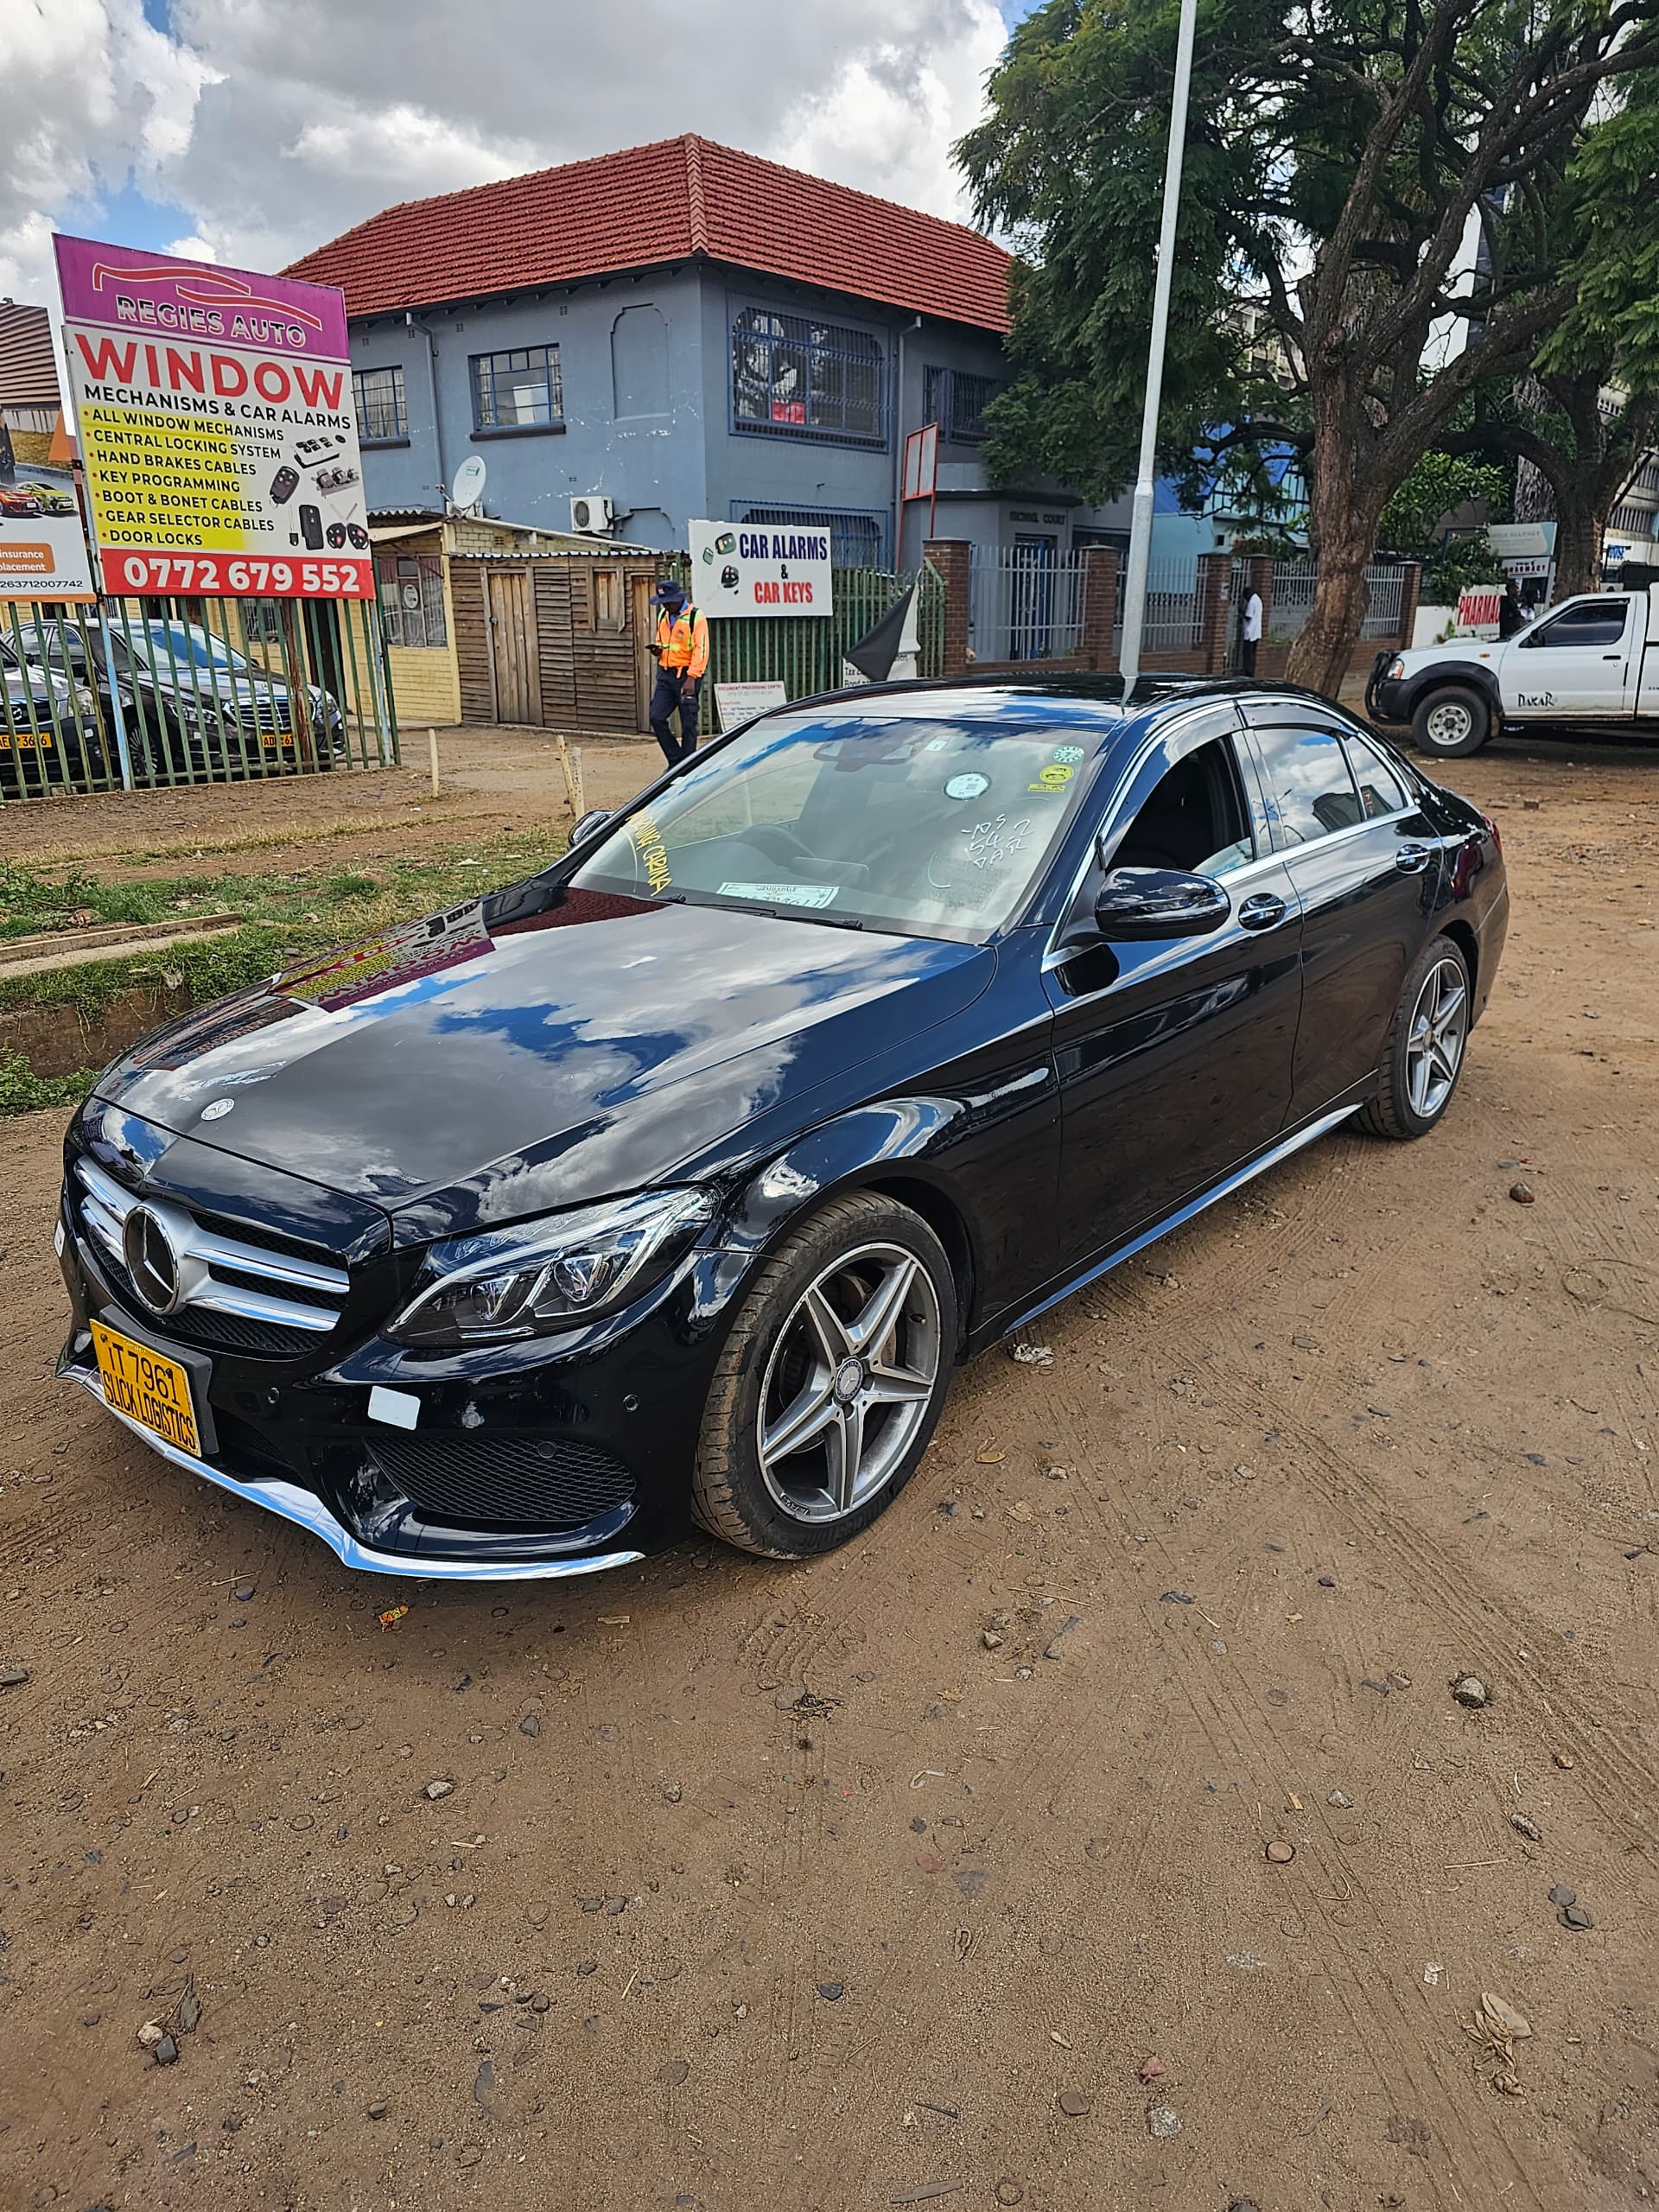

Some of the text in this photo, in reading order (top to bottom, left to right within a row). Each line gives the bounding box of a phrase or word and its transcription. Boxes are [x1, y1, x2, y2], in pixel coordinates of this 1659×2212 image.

[116, 295, 306, 347] REGIES AUTO
[74, 334, 344, 410] WINDOW
[84, 384, 351, 429] MECHANISMS & CAR ALARMS
[92, 409, 284, 441] ALL WINDOW MECHANISMS
[94, 429, 281, 459] CENTRAL LOCKING SYSTEM
[97, 449, 257, 475] HAND BRAKES CABLES
[100, 470, 240, 493] KEY PROGRAMMING
[102, 490, 263, 512] BOOT & BONET CABLES
[106, 510, 275, 531] GEAR SELECTOR CABLES
[110, 530, 202, 545] DOOR LOCKS
[740, 533, 828, 560] CAR ALARMS
[124, 556, 360, 593] 0772 679 552
[781, 563, 789, 580] &
[753, 581, 813, 604] CAR KEYS
[22, 735, 47, 747] 366
[642, 845, 672, 897] CARINA
[128, 1350, 180, 1407] 7961
[103, 1370, 196, 1450] SLICK LOGISTICS
